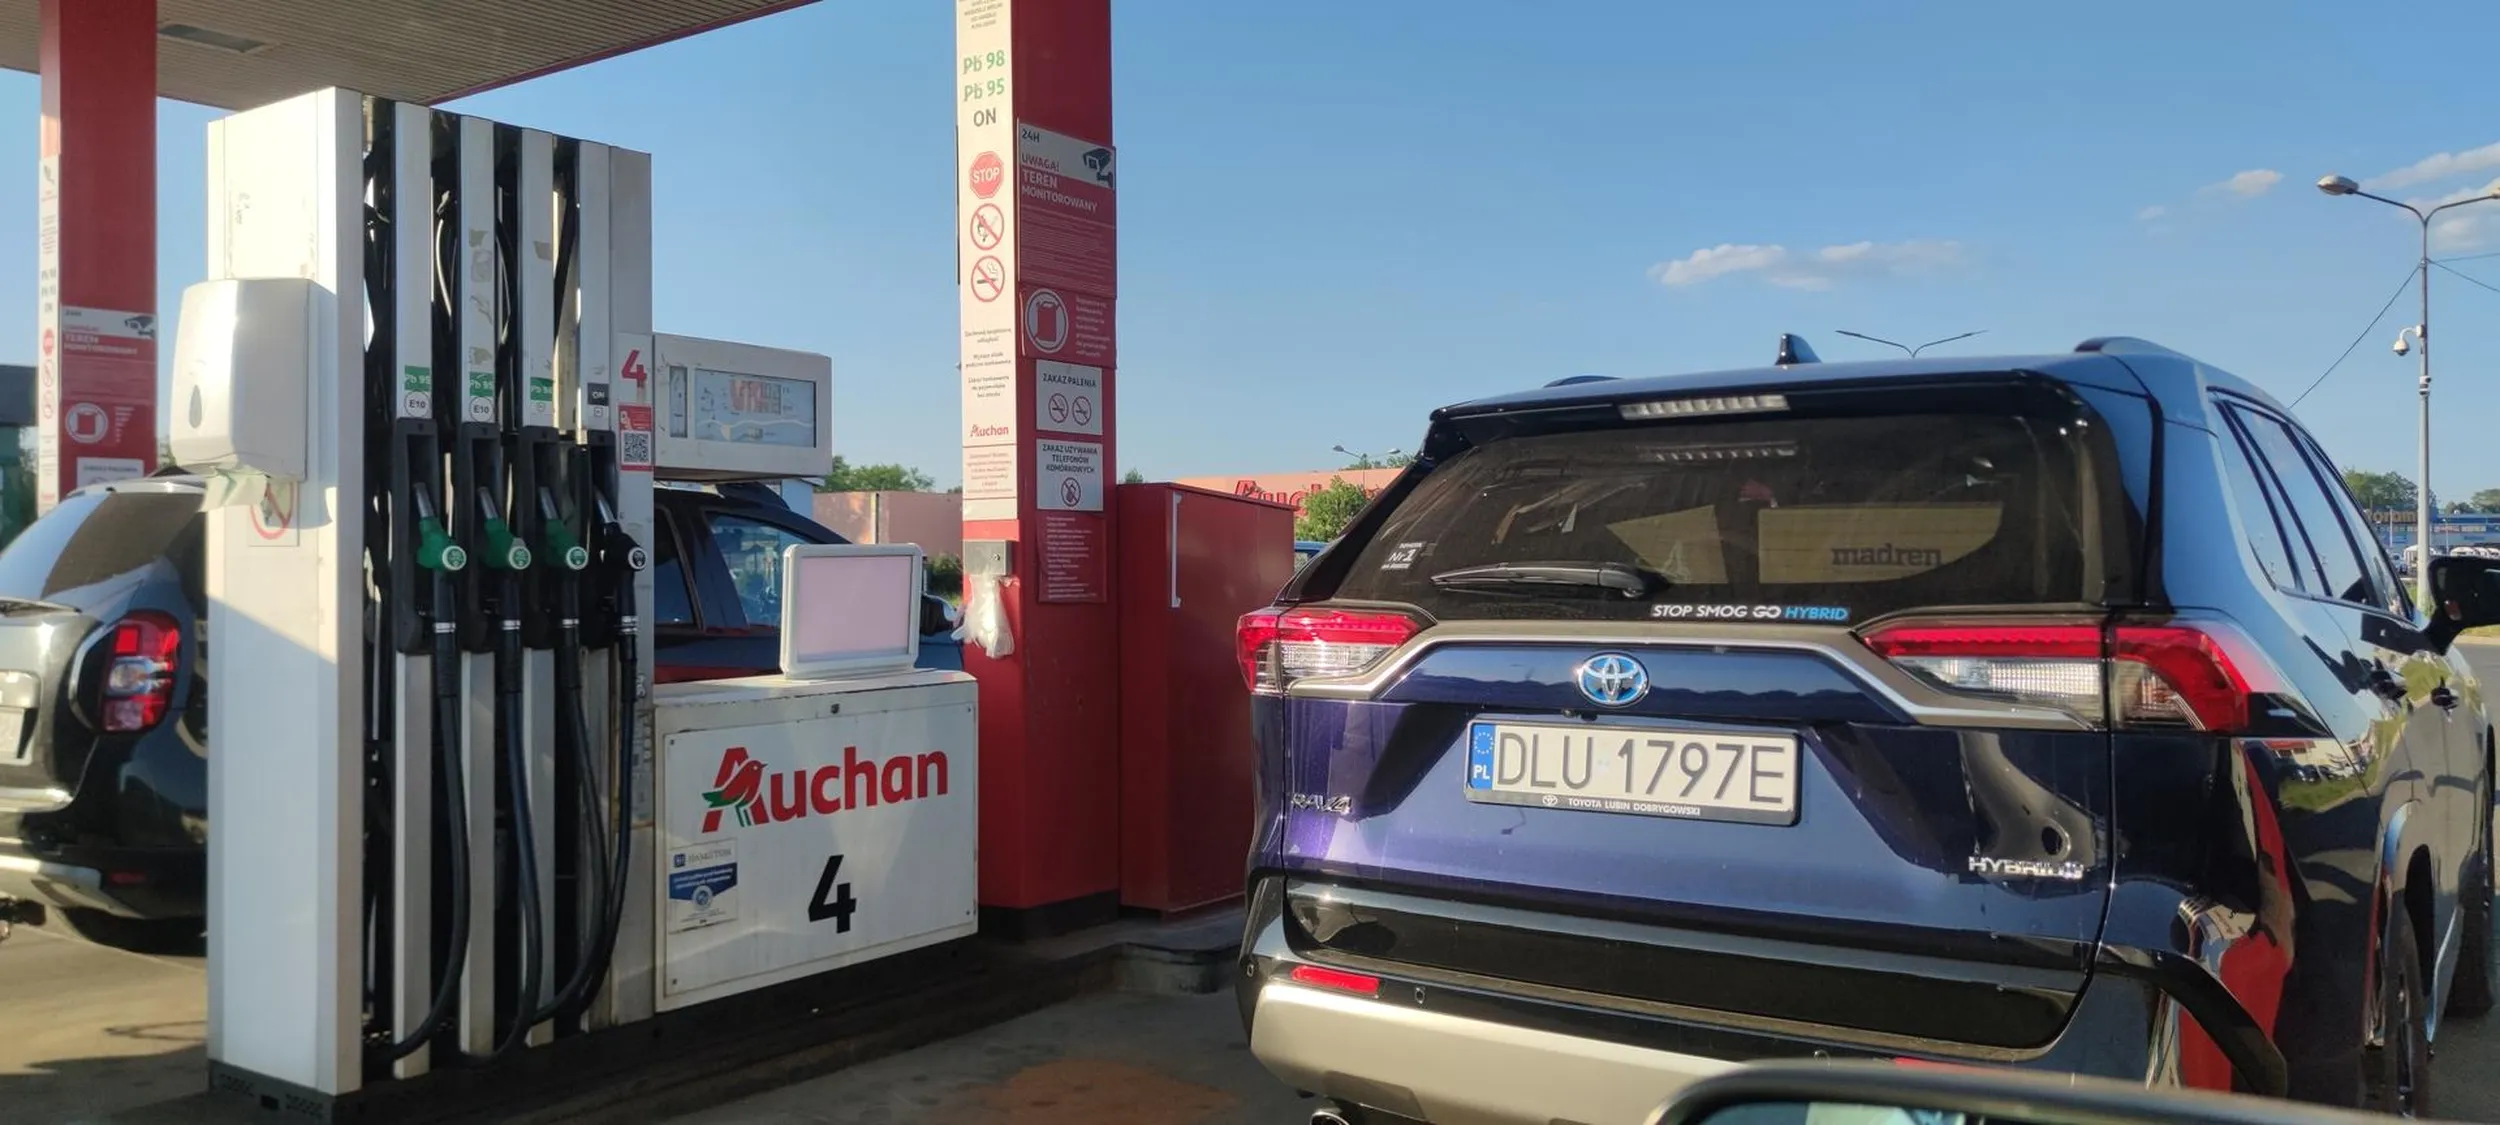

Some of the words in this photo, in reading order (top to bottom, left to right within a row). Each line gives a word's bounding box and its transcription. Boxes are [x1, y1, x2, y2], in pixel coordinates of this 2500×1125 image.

[963, 54, 982, 75] Pb
[986, 49, 1005, 70] 98
[964, 82, 982, 102] Pb
[986, 77, 1005, 97] 95
[973, 107, 996, 127] ON
[1021, 128, 1040, 143] 24H
[1021, 152, 1060, 173] UWAGA!
[973, 166, 1001, 184] STOP
[1022, 168, 1058, 188] TEREN
[1021, 185, 1098, 213] MONITOROWANY
[621, 349, 648, 388] 4
[1042, 373, 1067, 386] ZAKAZ
[408, 398, 427, 409] E10
[472, 404, 490, 414] E10
[970, 424, 1009, 437] Auchan
[1042, 443, 1064, 453] ZAKAZ
[1653, 604, 1693, 618] STOP
[1696, 604, 1748, 618] SMOG
[1752, 605, 1782, 619] GO
[1784, 606, 1848, 621] HYBRID
[1473, 764, 1491, 780] PL
[1497, 732, 1594, 790] DLU
[1617, 738, 1785, 804] 1797E
[702, 746, 948, 833] Auchan
[1290, 793, 1352, 815] RAV4
[1568, 797, 1602, 809] TOYOTA
[1604, 799, 1631, 811] LUBIN
[1633, 803, 1701, 816] DOBRYGOWSKI
[808, 855, 857, 934] 4
